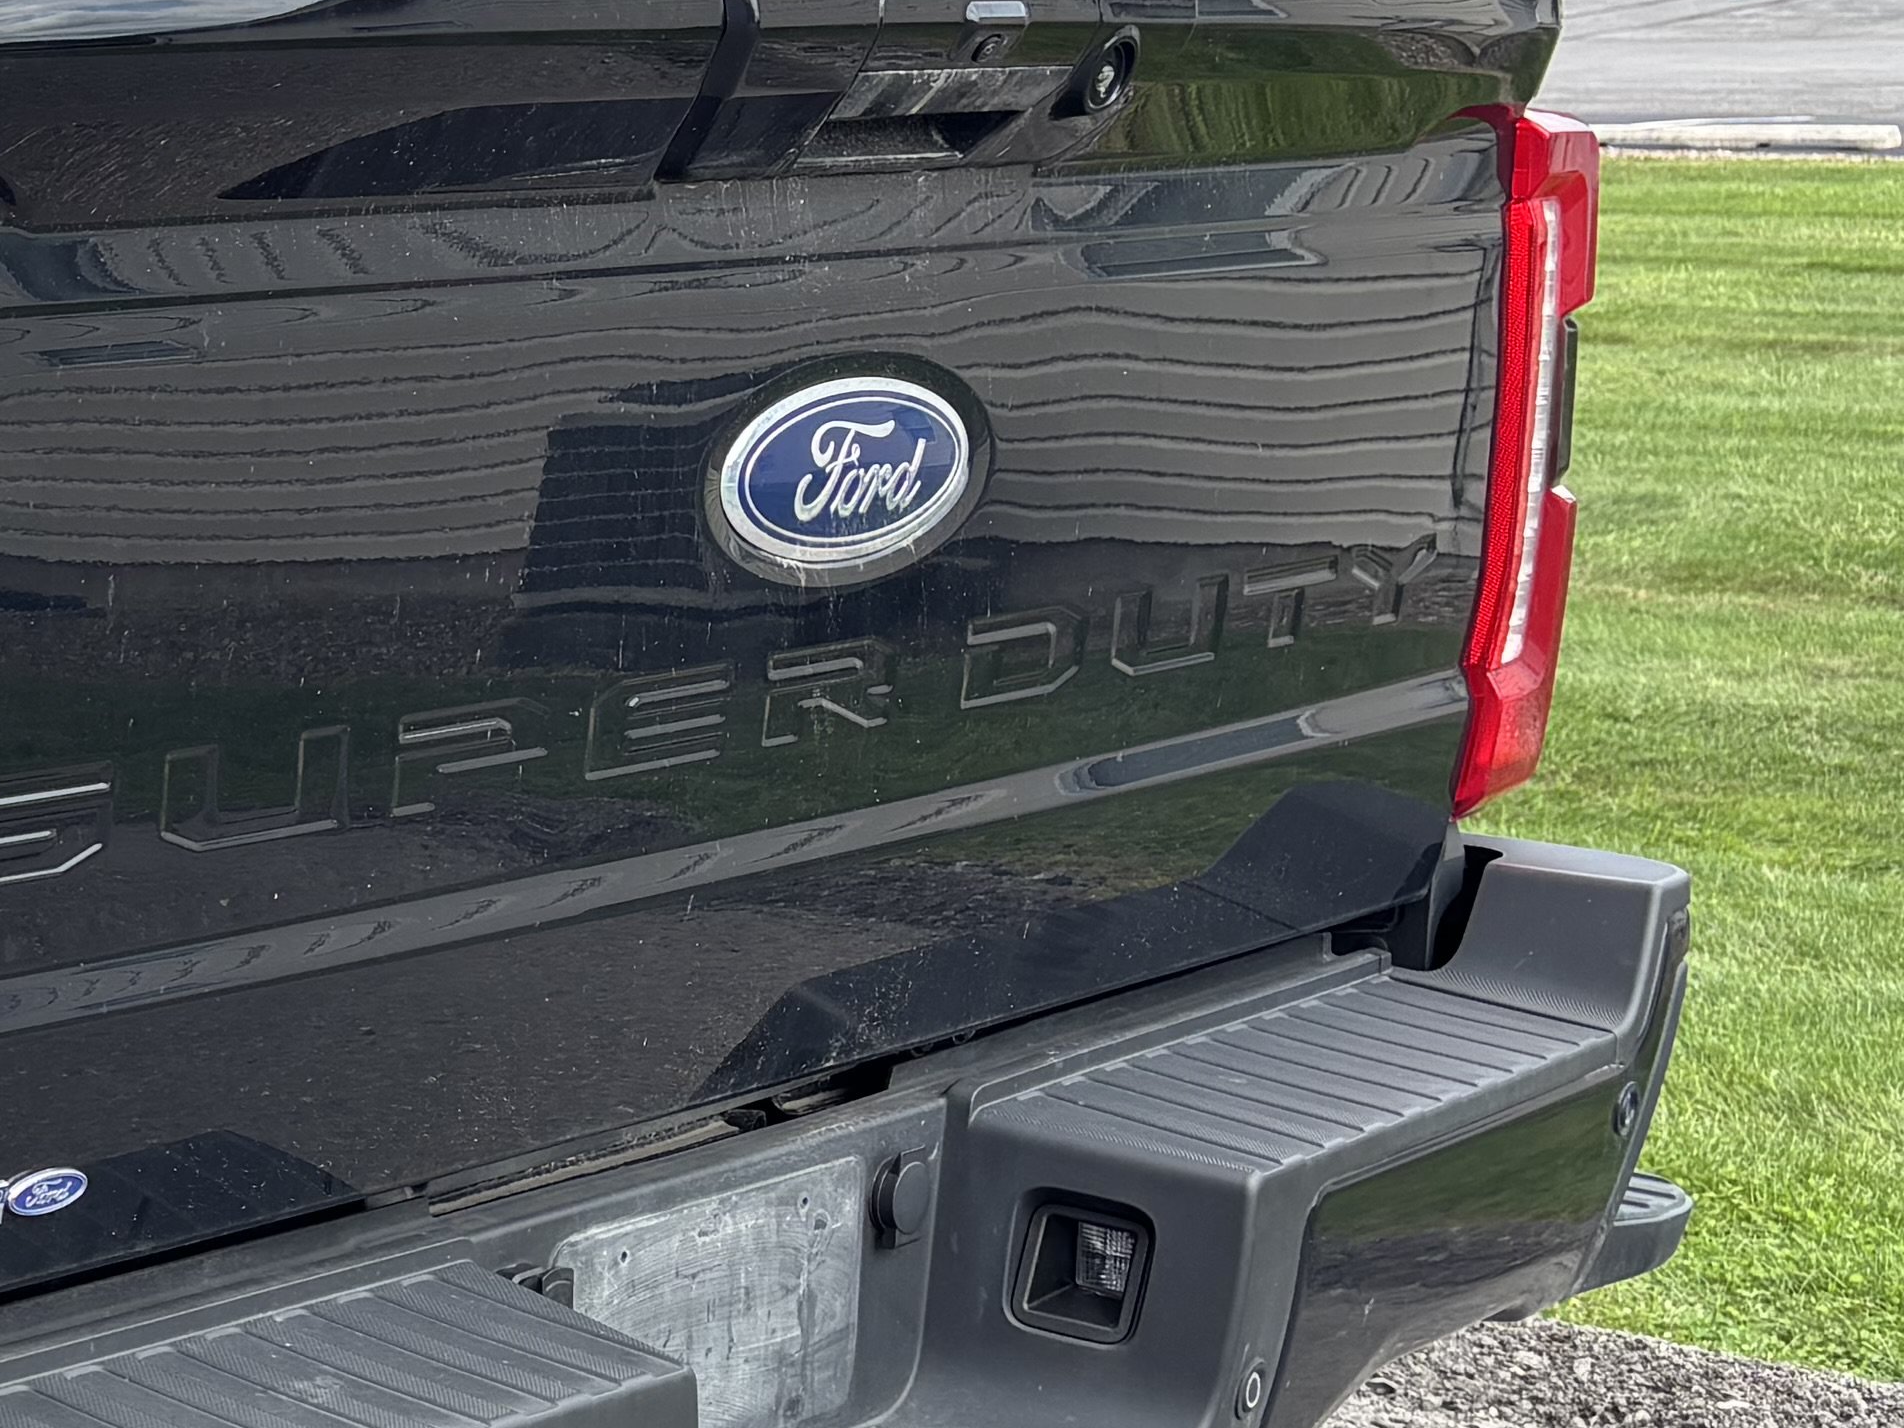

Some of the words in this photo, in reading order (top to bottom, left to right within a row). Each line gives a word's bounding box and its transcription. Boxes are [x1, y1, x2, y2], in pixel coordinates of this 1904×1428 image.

[794, 419, 927, 522] Ford
[959, 534, 1438, 710] DUTY
[25, 1178, 73, 1208] Ford
